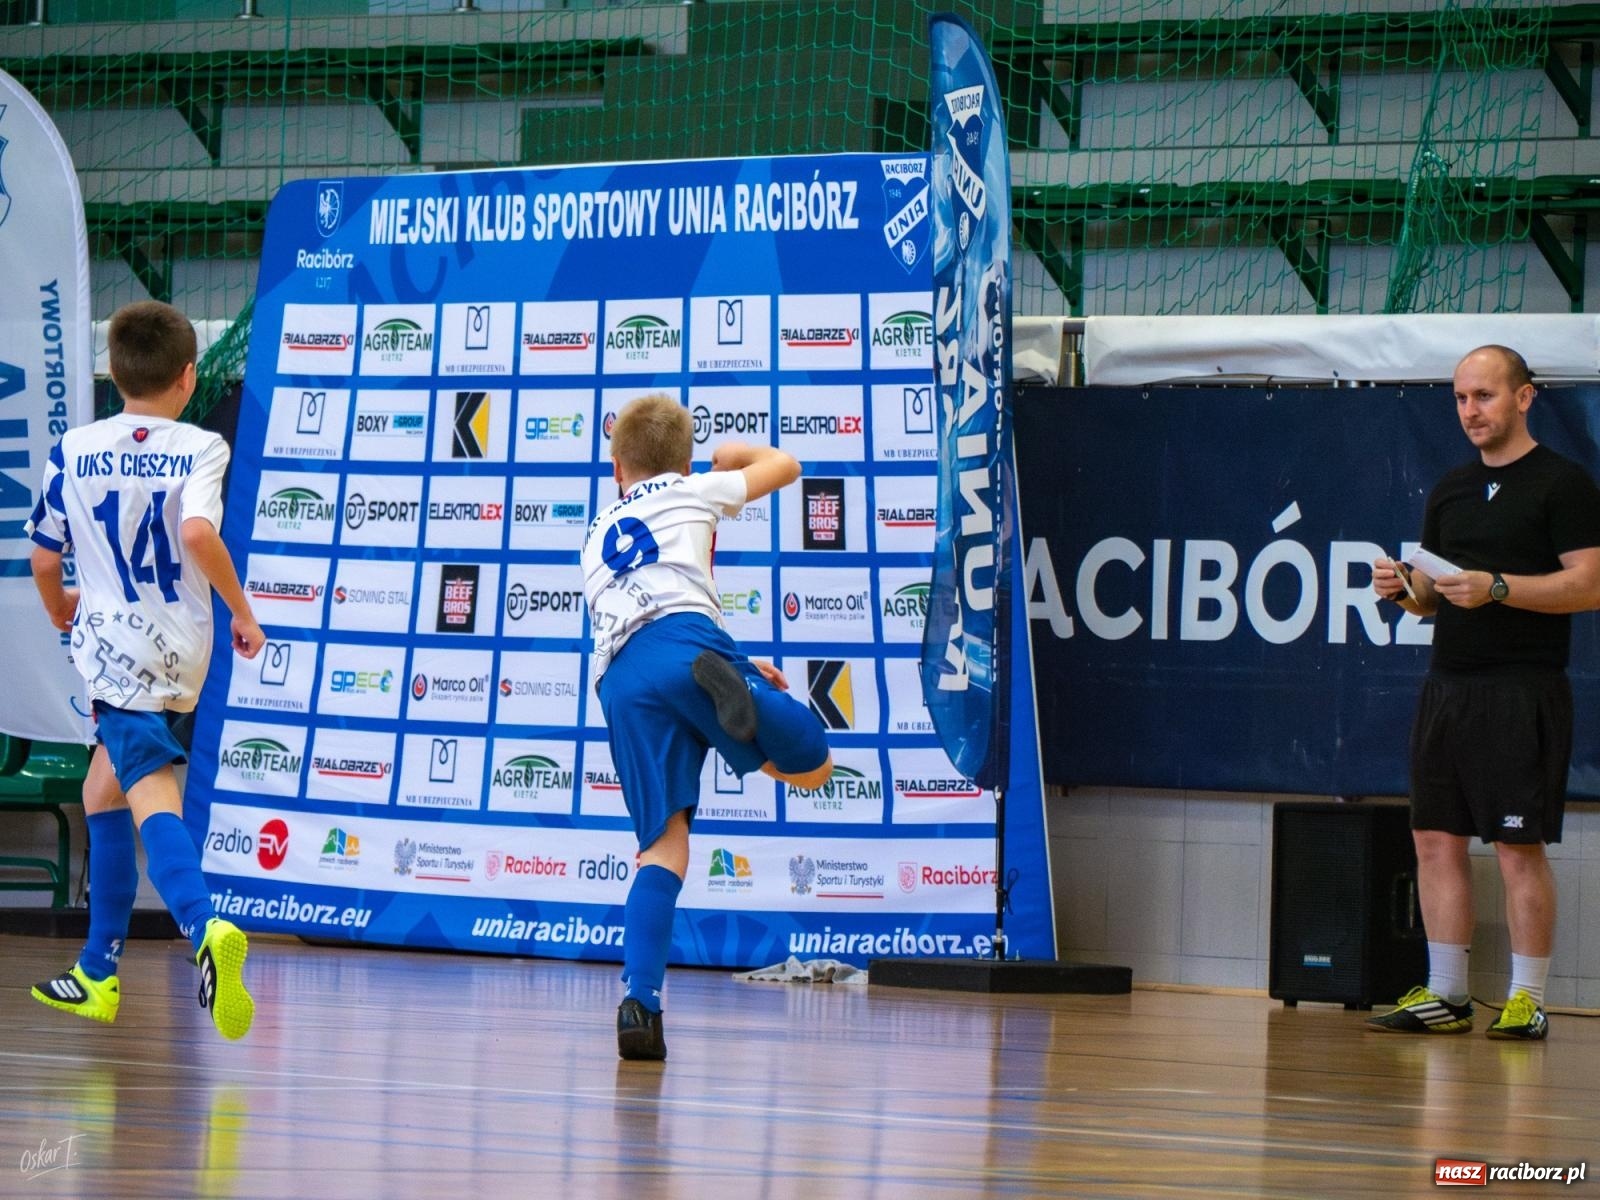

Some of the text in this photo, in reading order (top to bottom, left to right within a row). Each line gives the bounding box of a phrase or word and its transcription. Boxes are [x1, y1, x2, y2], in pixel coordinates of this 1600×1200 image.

[369, 169, 859, 245] MIEJSKI KLUB SPORTOWY UNIA RACIBÓRZ
[888, 198, 925, 241] UNIA
[296, 248, 354, 269] Racibórz
[872, 326, 933, 347] AGROTE
[357, 415, 389, 432] BOXY
[714, 412, 769, 434] SPORT
[780, 416, 862, 434] ELEKTROLEX
[76, 451, 193, 478] UKS CIESZYN
[368, 501, 419, 522] SPORT
[429, 503, 502, 520] ELEKTROLEX
[515, 504, 548, 522] BOXY
[808, 500, 840, 515] BEEF
[808, 516, 839, 530] BROS
[92, 490, 181, 603] 14
[602, 516, 660, 580] 9
[1025, 500, 1434, 646] ACIBÓR
[444, 585, 473, 600] BEEF
[529, 591, 582, 613] SPORT
[805, 595, 843, 611] Marco
[443, 601, 471, 614] BROS
[432, 677, 466, 692] Marco
[205, 827, 253, 855] radio
[419, 843, 462, 856] Ministerstwo
[504, 851, 567, 877] Racibórz
[578, 855, 629, 881] radio
[816, 859, 868, 872] Ministerstwo
[816, 875, 843, 887] Sportu
[849, 875, 885, 888] Turystyki
[922, 864, 998, 886] Racibórz
[210, 888, 372, 928] niaraciborz.eu
[472, 912, 625, 947] uniaraciborz
